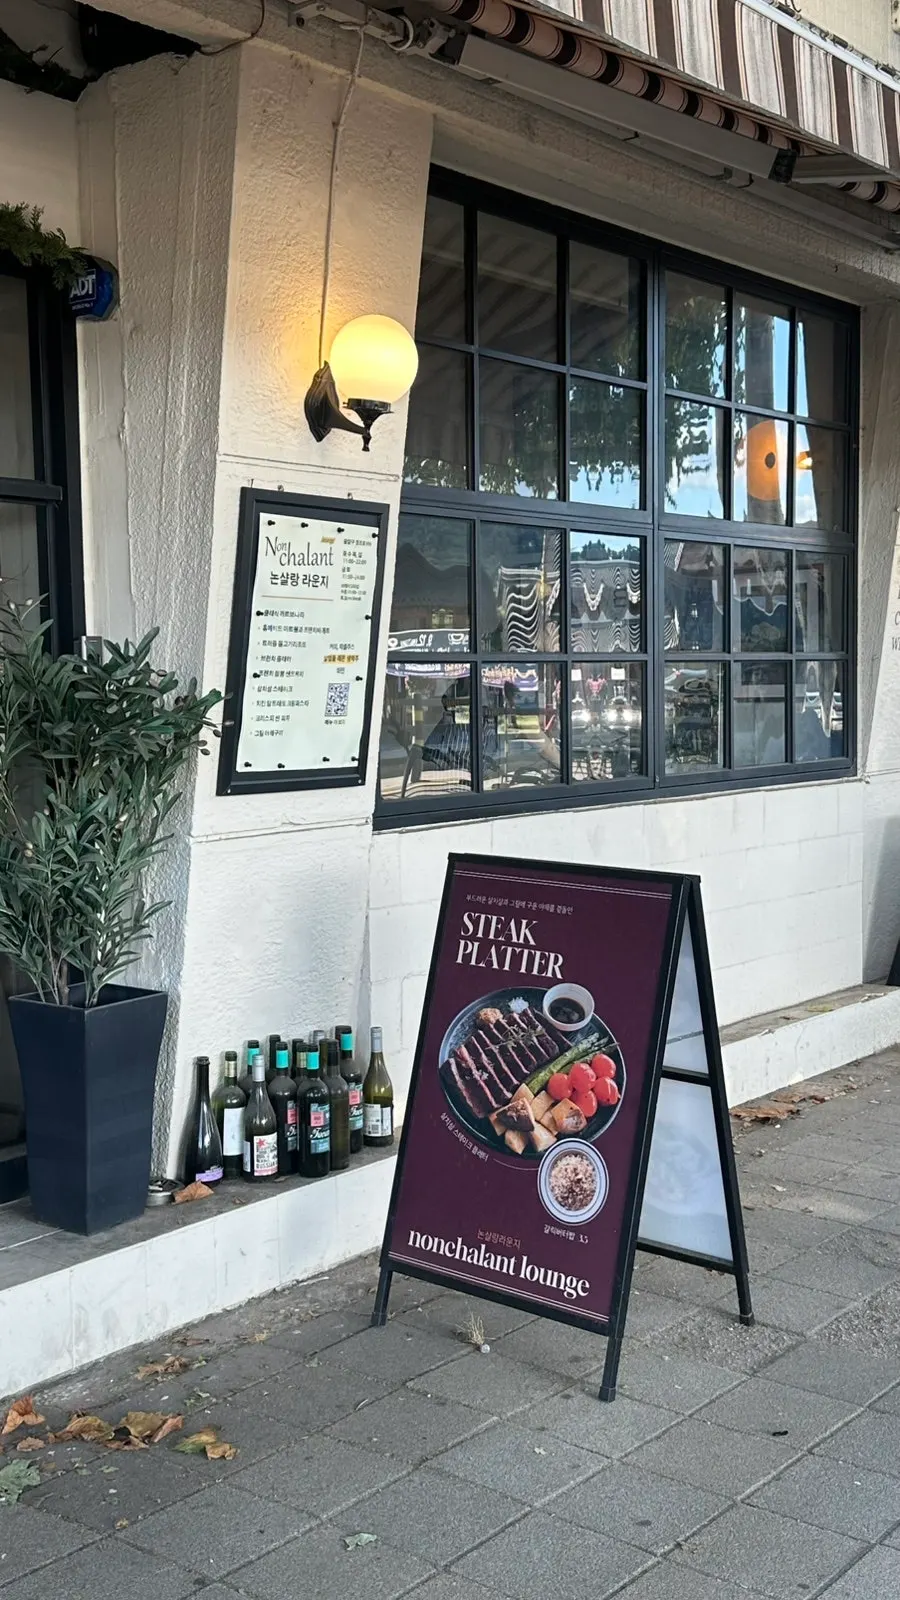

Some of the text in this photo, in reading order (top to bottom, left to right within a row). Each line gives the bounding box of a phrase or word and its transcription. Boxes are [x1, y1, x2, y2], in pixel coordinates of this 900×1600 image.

[70, 275, 95, 298] ADT
[265, 536, 287, 557] Non
[280, 541, 334, 566] chalant
[270, 571, 329, 589] 논샬랑 라운지
[466, 893, 486, 904] 부드러운
[527, 901, 538, 911] 구운
[461, 911, 539, 945] STEAK
[456, 939, 563, 979] PLATTER
[453, 1129, 473, 1150] 스테이크
[543, 1224, 576, 1241] 갈릭버터밥
[408, 1229, 590, 1300] nonchalant lounge
